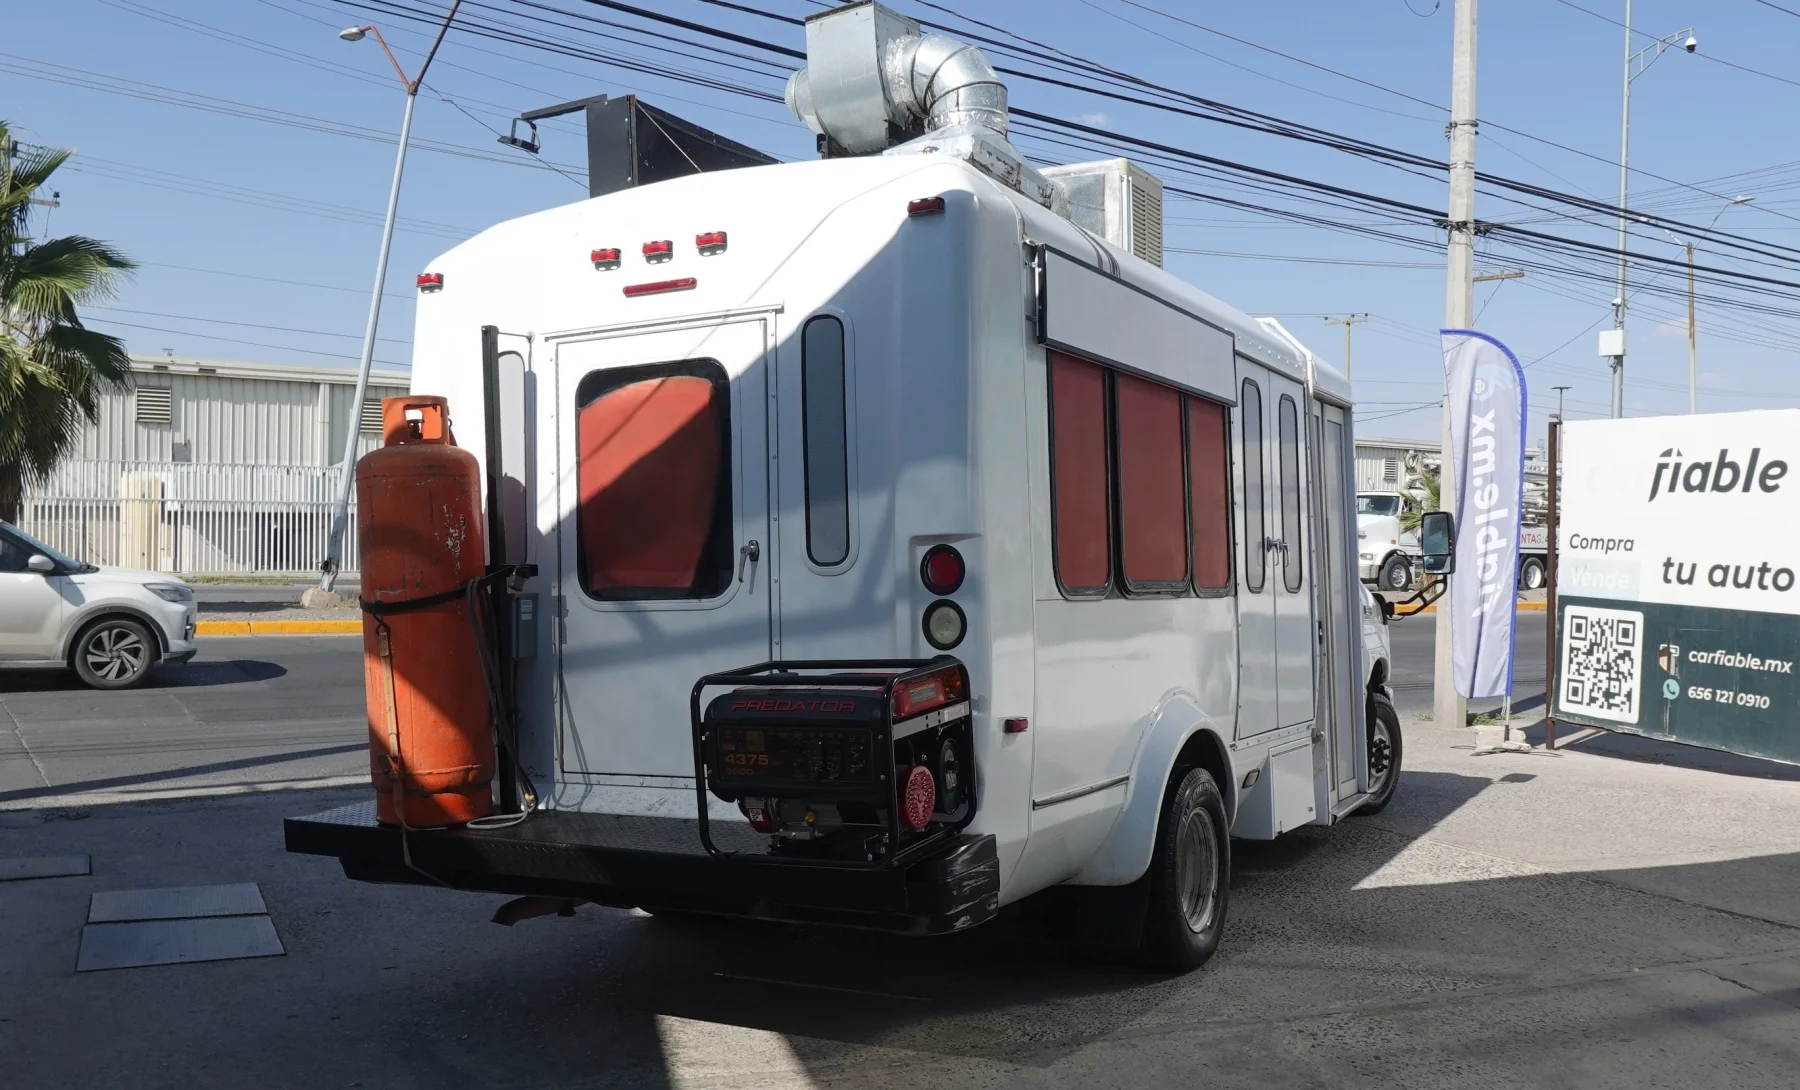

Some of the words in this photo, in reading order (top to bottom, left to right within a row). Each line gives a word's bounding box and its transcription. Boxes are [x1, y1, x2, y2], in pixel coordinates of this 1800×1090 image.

[1521, 533, 1544, 544] NTAS:
[1569, 533, 1635, 554] Compra
[1570, 566, 1630, 589] Vende
[1662, 556, 1698, 586] tu
[1707, 561, 1796, 593] auto
[1688, 649, 1793, 674] carfiable.mx
[731, 700, 857, 713] PREDATOR
[1687, 686, 1712, 701] 656
[1715, 689, 1734, 704] 121
[1736, 693, 1770, 709] 0910
[725, 753, 769, 766] 4375
